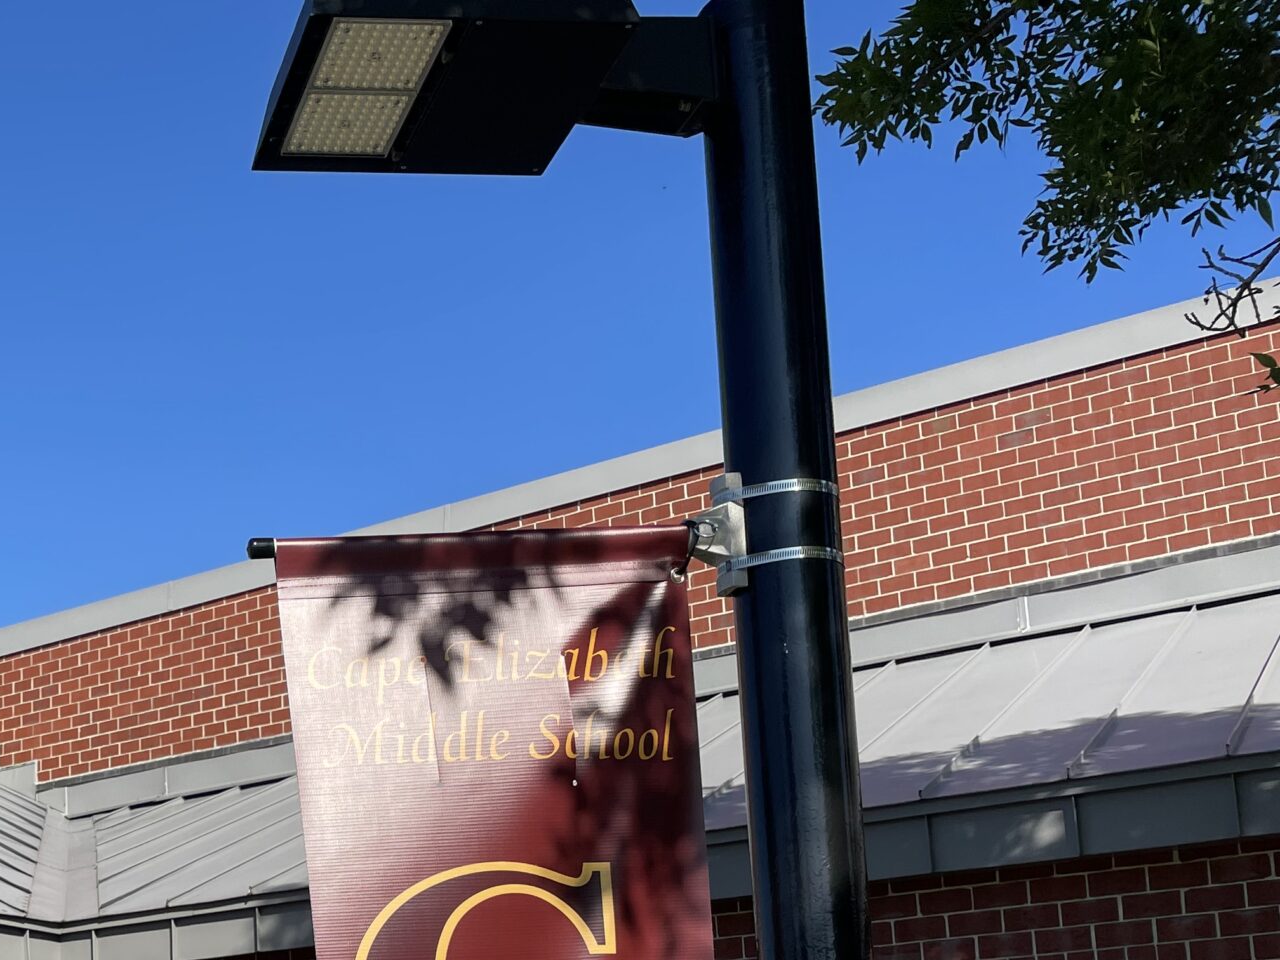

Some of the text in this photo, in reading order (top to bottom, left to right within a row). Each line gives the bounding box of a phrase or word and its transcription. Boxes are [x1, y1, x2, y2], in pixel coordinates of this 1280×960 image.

[306, 626, 676, 706] Cape Elizabeth
[322, 707, 675, 769] Middle School
